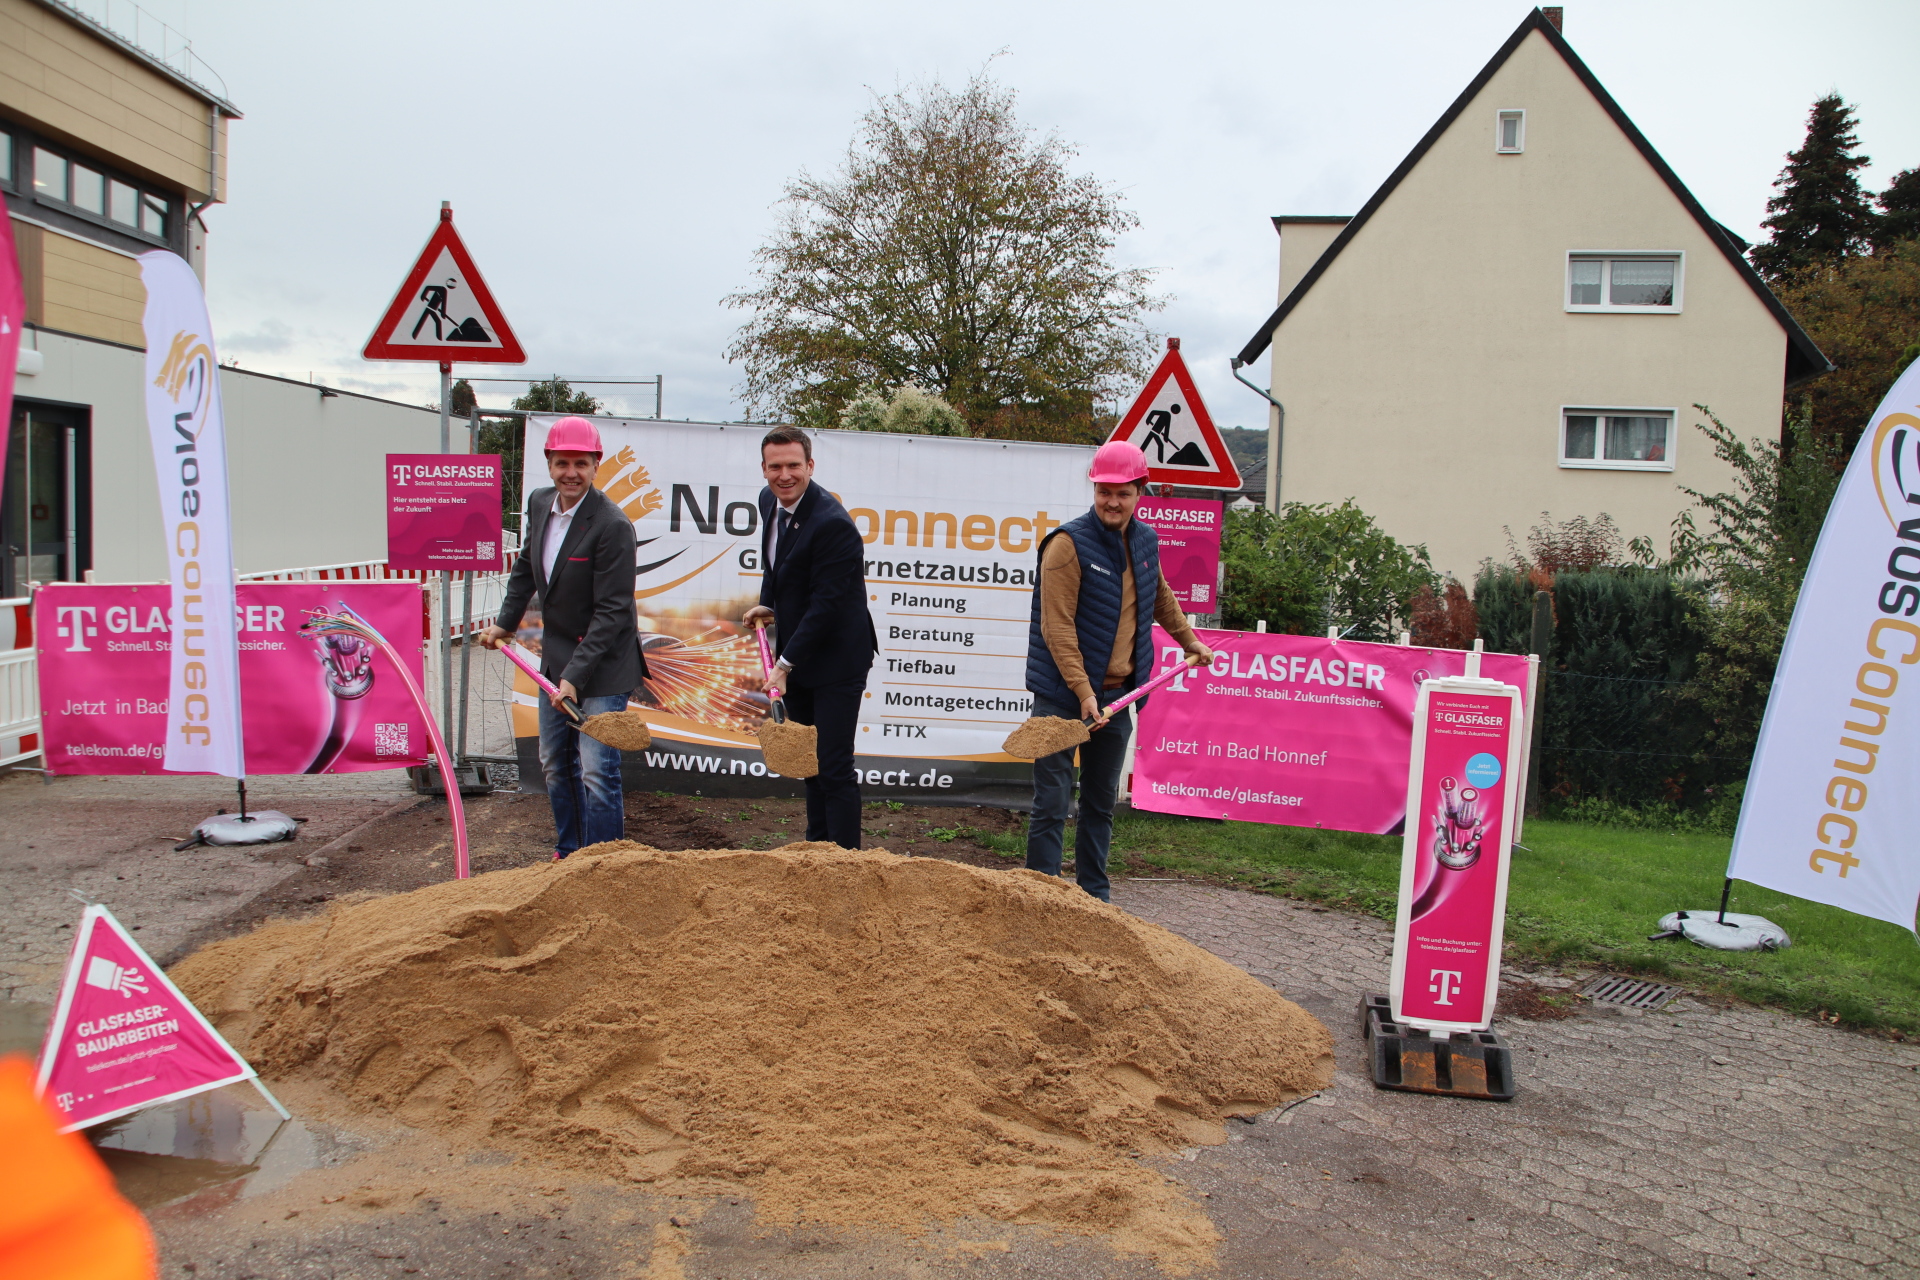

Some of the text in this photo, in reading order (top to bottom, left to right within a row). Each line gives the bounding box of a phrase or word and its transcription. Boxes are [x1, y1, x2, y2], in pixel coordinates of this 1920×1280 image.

[414, 465, 495, 479] GLASFASER
[393, 496, 407, 504] Hier
[1137, 506, 1215, 524] GLASFASER
[1175, 524, 1214, 532] Zukunftssicher.
[1171, 539, 1187, 547] Netz
[890, 592, 967, 613] Planung
[888, 625, 975, 646] Beratung
[107, 640, 153, 652] Schnell.
[887, 658, 956, 676] Tiefbau
[1207, 650, 1386, 691] GLASFASER
[884, 691, 1035, 716] Montagetechnik
[1206, 683, 1384, 709] Schnell. Stabil. Zukunftssicher.
[61, 698, 169, 716] Jetzt in Bad
[1444, 712, 1503, 727] GLASFASER
[883, 723, 927, 739] FTTX
[1468, 730, 1501, 738] Zukunftssicher.
[1155, 737, 1328, 766] Jetzt in Bad Honnef
[1151, 780, 1304, 808] telekom.de/glasfaser
[1416, 935, 1430, 943] Infos
[1442, 938, 1466, 947] Buchung
[1420, 943, 1477, 954] telekom.de/glasfaser
[77, 1005, 168, 1037] GLASFASER-
[76, 1020, 179, 1057] BAUARBEITEN
